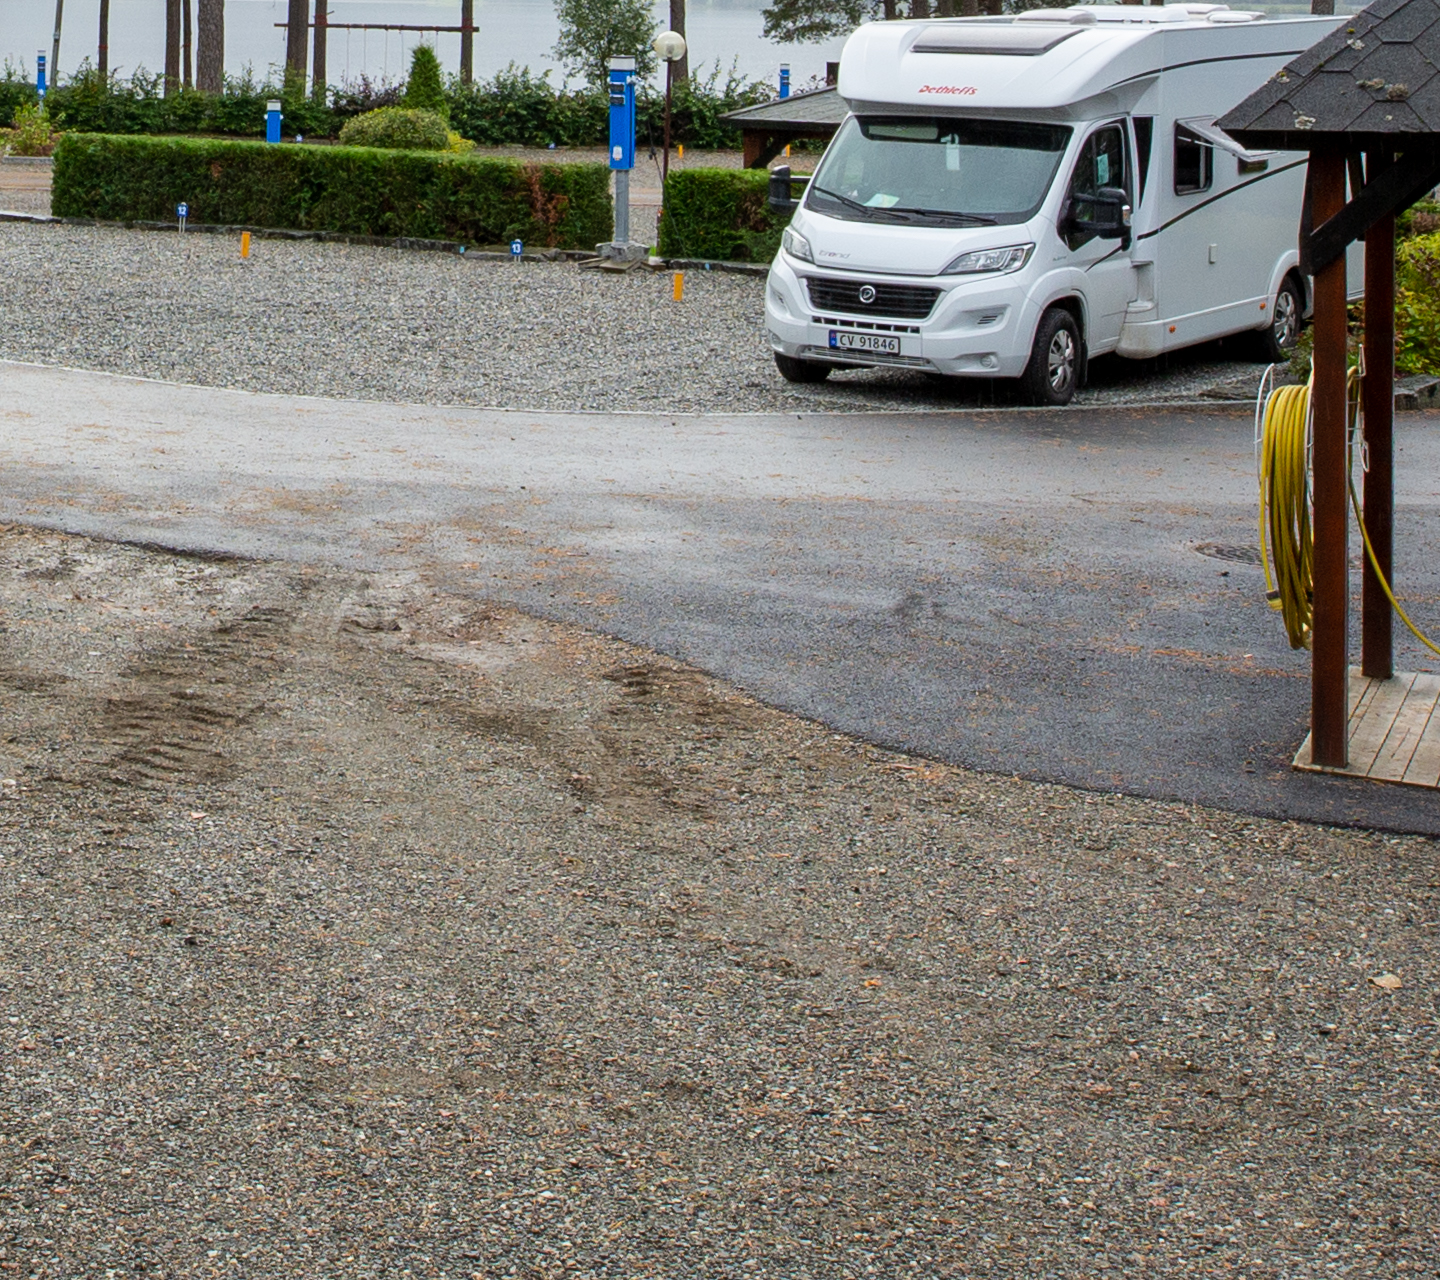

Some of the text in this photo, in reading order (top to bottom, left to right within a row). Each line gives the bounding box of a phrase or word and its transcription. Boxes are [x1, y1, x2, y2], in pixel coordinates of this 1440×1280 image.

[511, 243, 521, 254] 13
[839, 334, 896, 351] CV 91846
